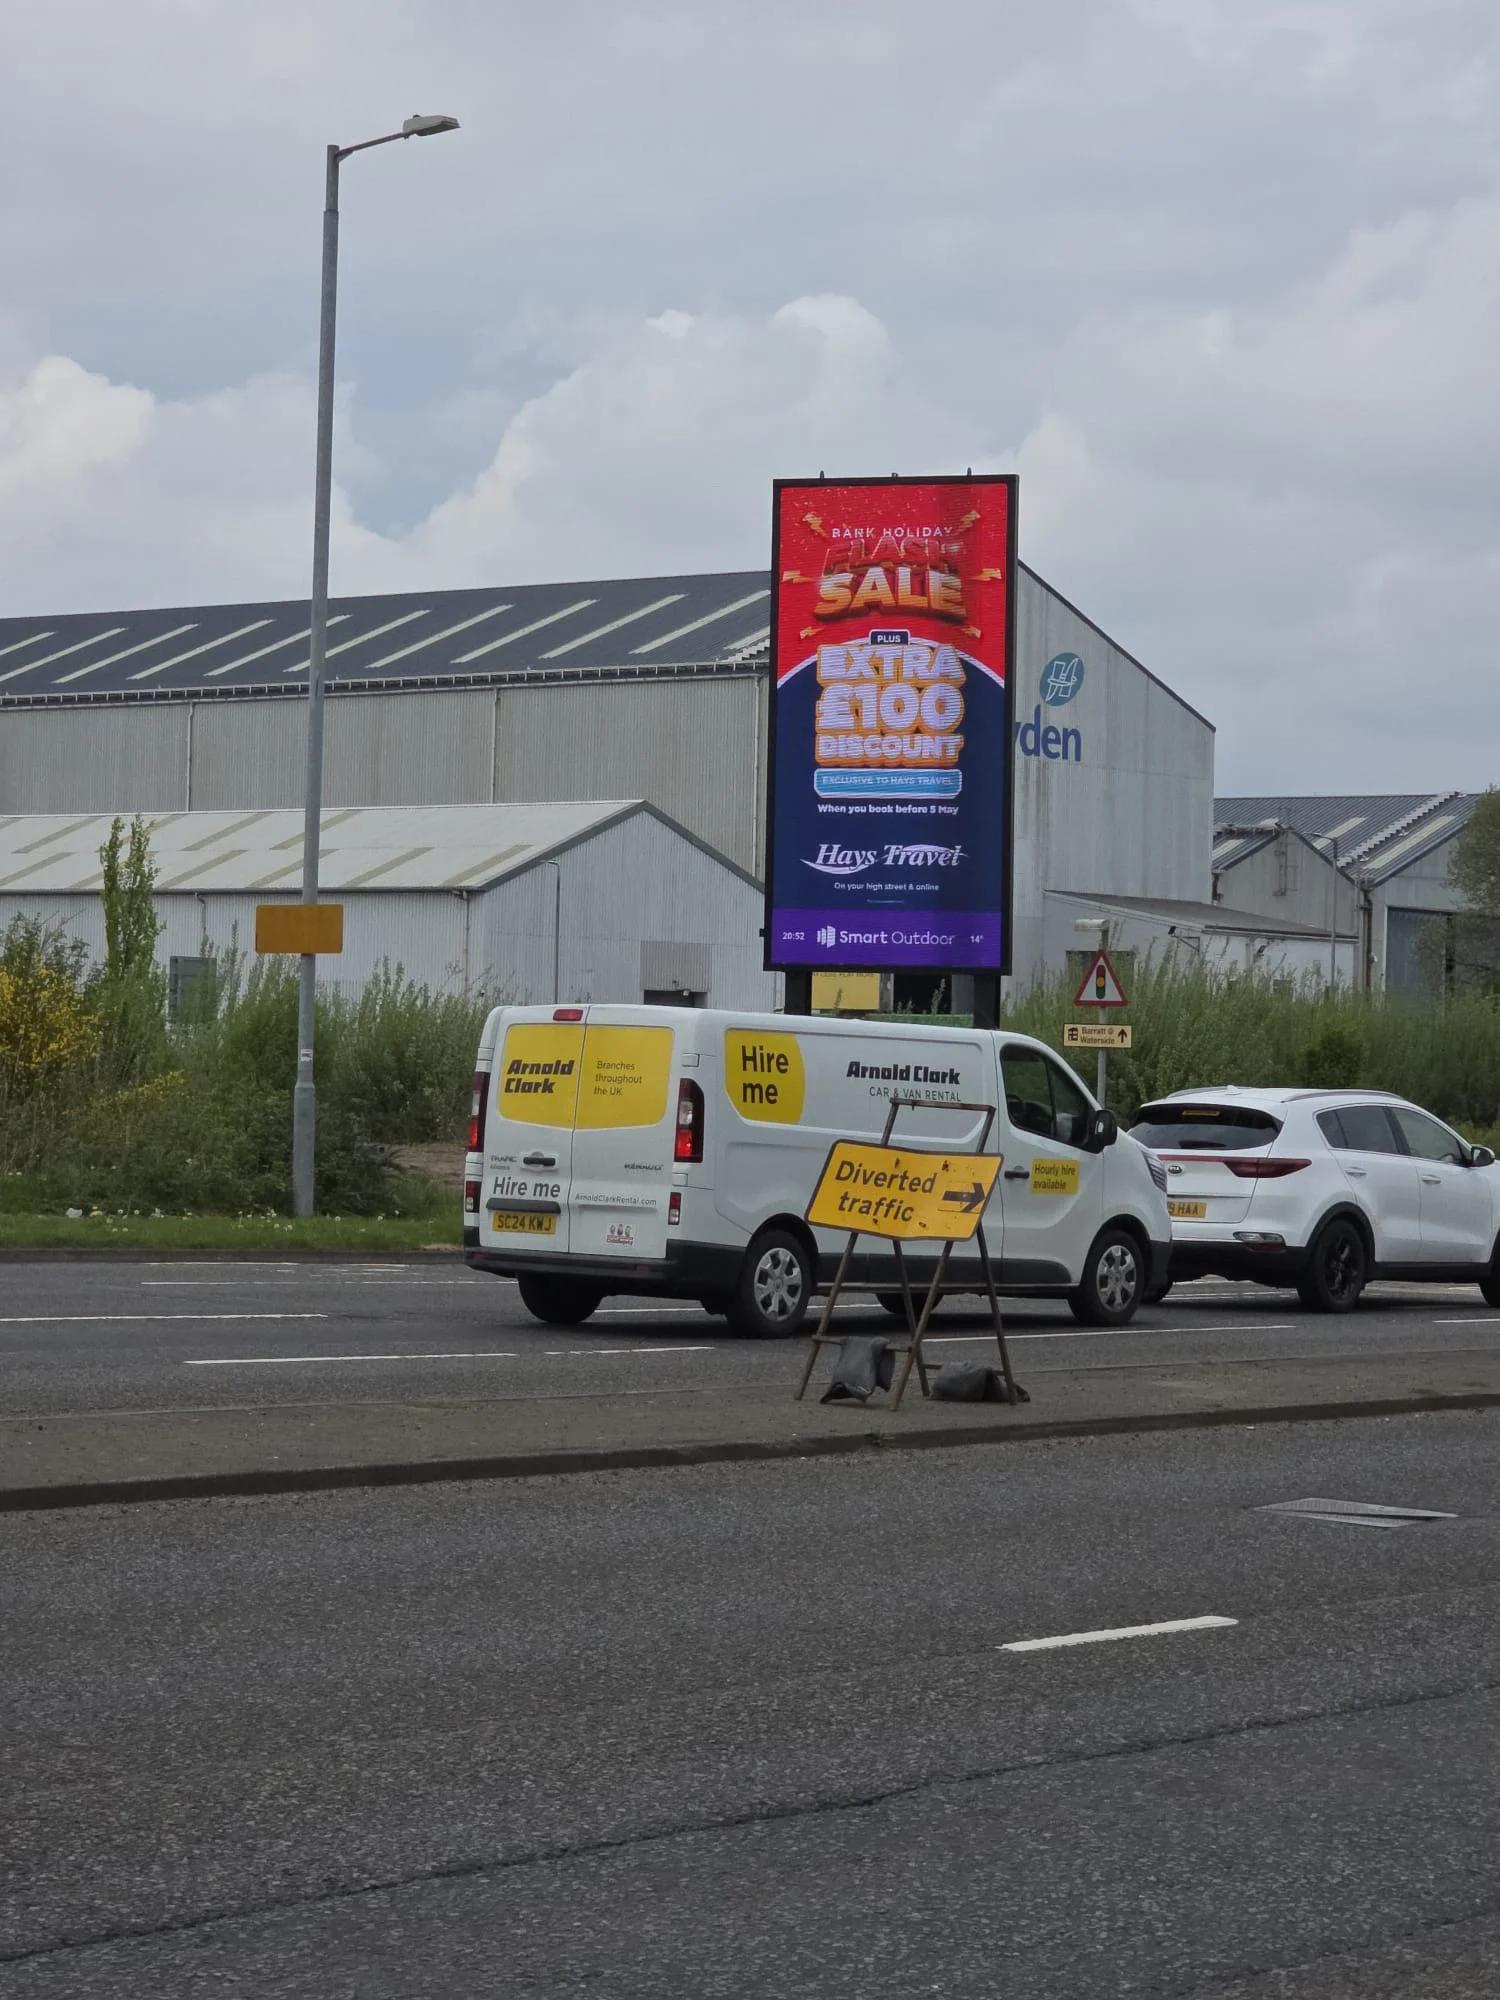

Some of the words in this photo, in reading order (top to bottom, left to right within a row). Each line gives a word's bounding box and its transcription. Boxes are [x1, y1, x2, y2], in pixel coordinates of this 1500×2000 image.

[831, 528, 875, 538] BANK
[883, 527, 953, 538] HOLIDAY
[814, 565, 967, 618] SALE
[877, 635, 901, 643] PLUS
[818, 645, 965, 682] EXTRA
[818, 682, 964, 731] £100
[817, 734, 964, 760] DISCOUNT
[822, 776, 873, 785] EXCLUSIVE
[877, 776, 889, 785] TO
[890, 776, 915, 785] HAYS
[918, 776, 953, 785] TRAVEL
[817, 804, 846, 814] When
[848, 805, 867, 815] you
[868, 804, 894, 814] book
[895, 804, 928, 814] before
[929, 805, 936, 814] 5
[938, 805, 960, 815] May
[816, 844, 878, 870] Hays
[883, 844, 963, 867] Travel
[834, 882, 846, 890] On
[847, 883, 865, 891] your
[866, 882, 884, 891] high
[884, 883, 907, 891] street
[916, 883, 940, 891] online
[781, 931, 805, 941] 20:52
[839, 930, 889, 945] Smart
[891, 930, 956, 945] Outdoor
[507, 1059, 575, 1076] Arnold
[596, 1060, 636, 1072] Branches
[741, 1045, 790, 1074] Hire
[595, 1073, 643, 1085] throughout
[846, 1061, 911, 1082] Arnold
[913, 1065, 961, 1085] Clark
[504, 1077, 556, 1094] Clark
[593, 1086, 608, 1096] the
[609, 1087, 623, 1096] UK
[742, 1081, 779, 1105] me
[869, 1086, 890, 1098] CAR
[892, 1087, 899, 1098] &
[903, 1088, 922, 1100] VAN
[925, 1090, 962, 1102] RENTAL
[834, 1160, 937, 1194] Diverted
[1034, 1163, 1059, 1177] Hourly
[1061, 1164, 1076, 1176] hire
[493, 1176, 528, 1196] Hire
[533, 1182, 561, 1198] me
[1033, 1178, 1067, 1190] available
[574, 1193, 657, 1206] ArnoldClarkRental.com
[838, 1191, 915, 1223] traffic
[497, 1214, 526, 1230] SC24
[528, 1216, 553, 1232] KWJ
